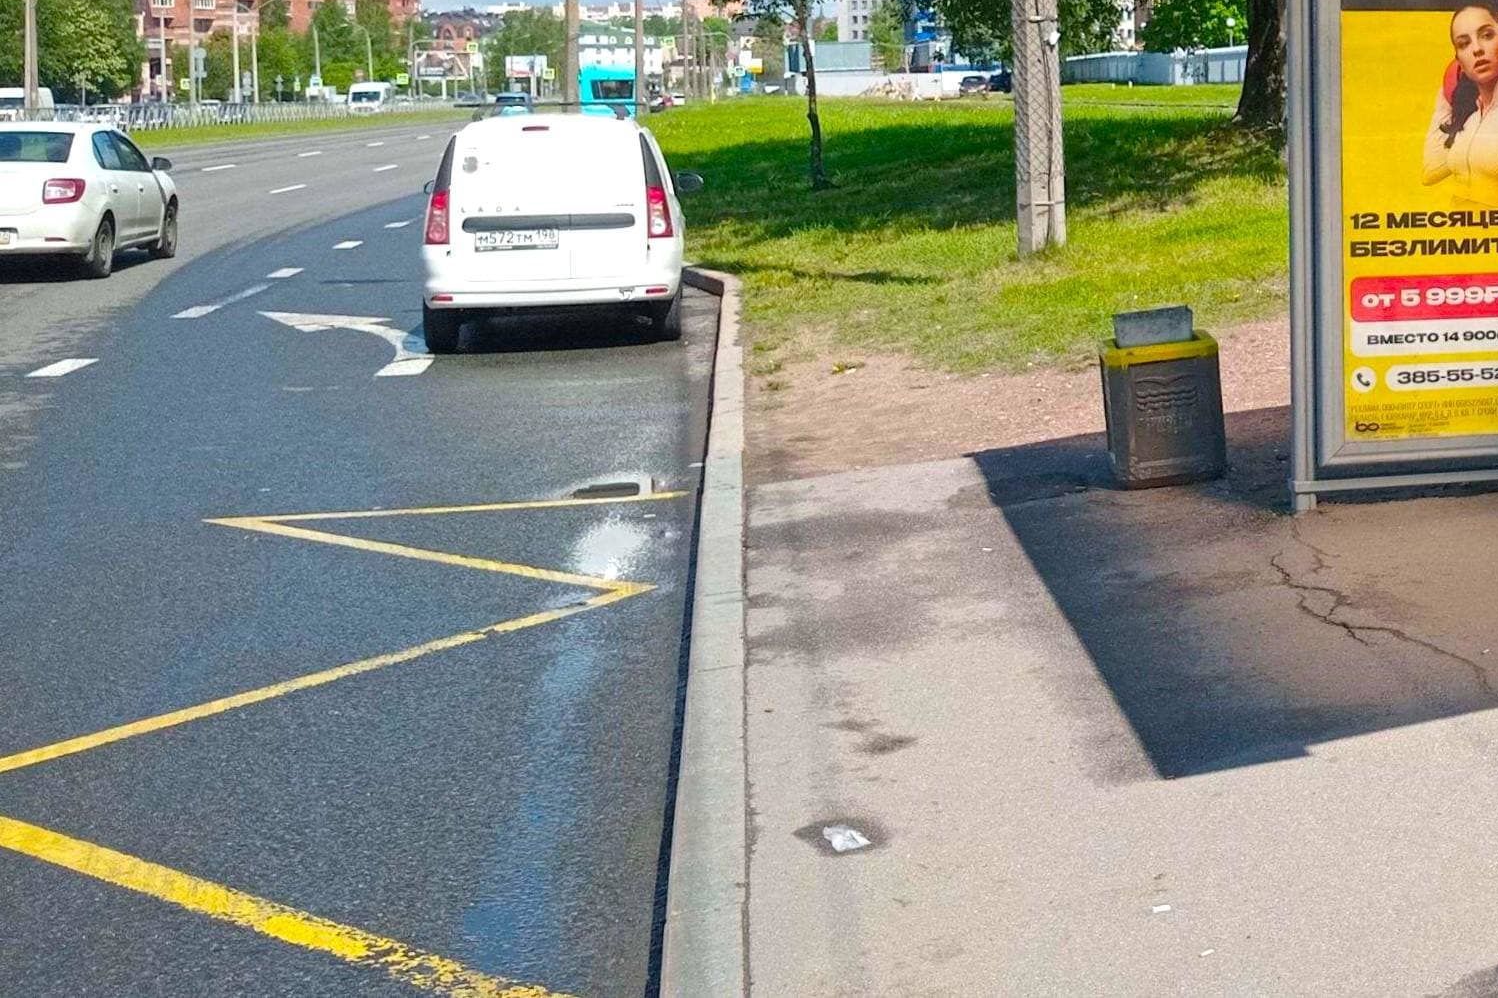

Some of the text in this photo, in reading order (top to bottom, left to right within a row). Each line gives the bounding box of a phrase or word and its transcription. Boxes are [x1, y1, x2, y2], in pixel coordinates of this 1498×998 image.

[1350, 212, 1380, 229] 12
[1361, 293, 1395, 308] от
[1401, 289, 1421, 307] 5
[1367, 332, 1439, 345] ВМЕСТО
[1443, 332, 1460, 342] 14
